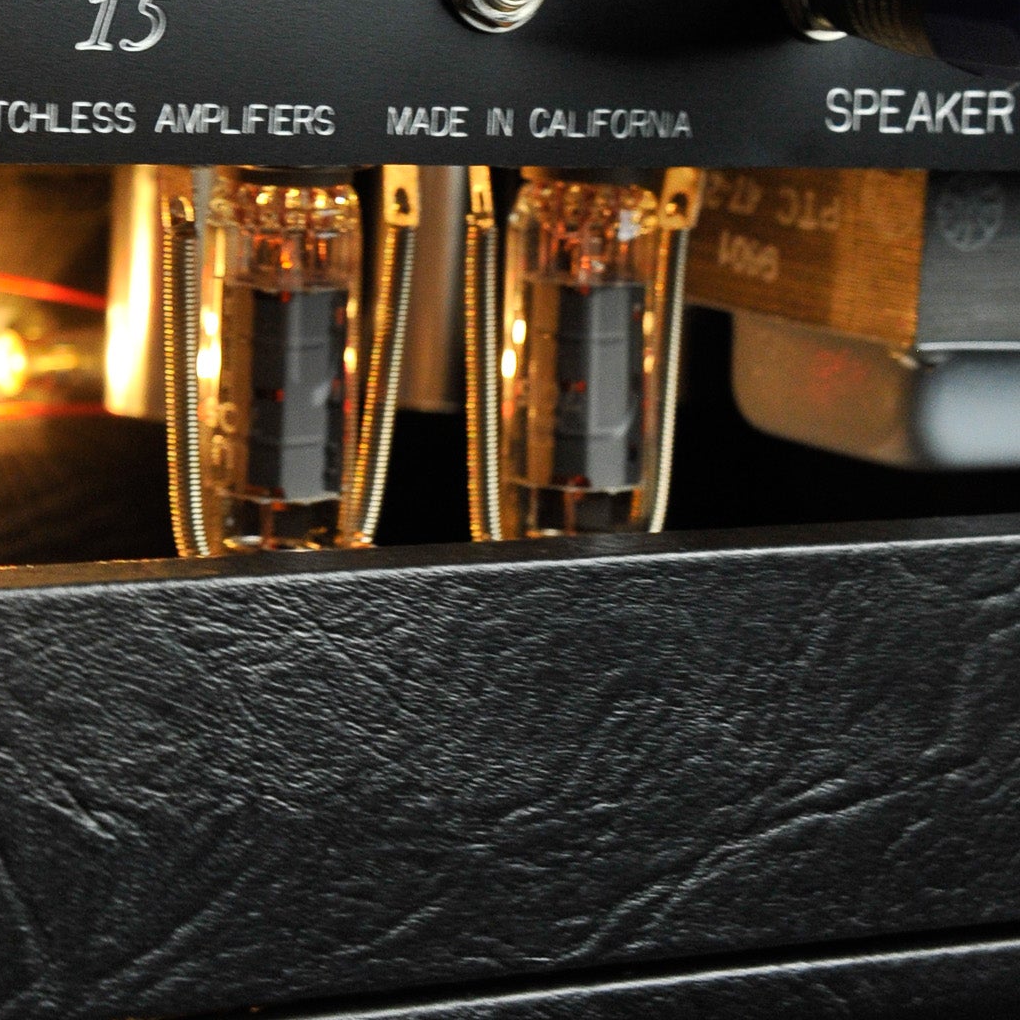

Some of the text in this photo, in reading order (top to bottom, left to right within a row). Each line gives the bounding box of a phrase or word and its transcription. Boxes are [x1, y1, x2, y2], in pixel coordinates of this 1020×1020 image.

[154, 103, 337, 137] AMPLIFIERS
[386, 105, 694, 140] MADE IN CALIFORNIA
[824, 87, 1015, 136] SPEAKER
